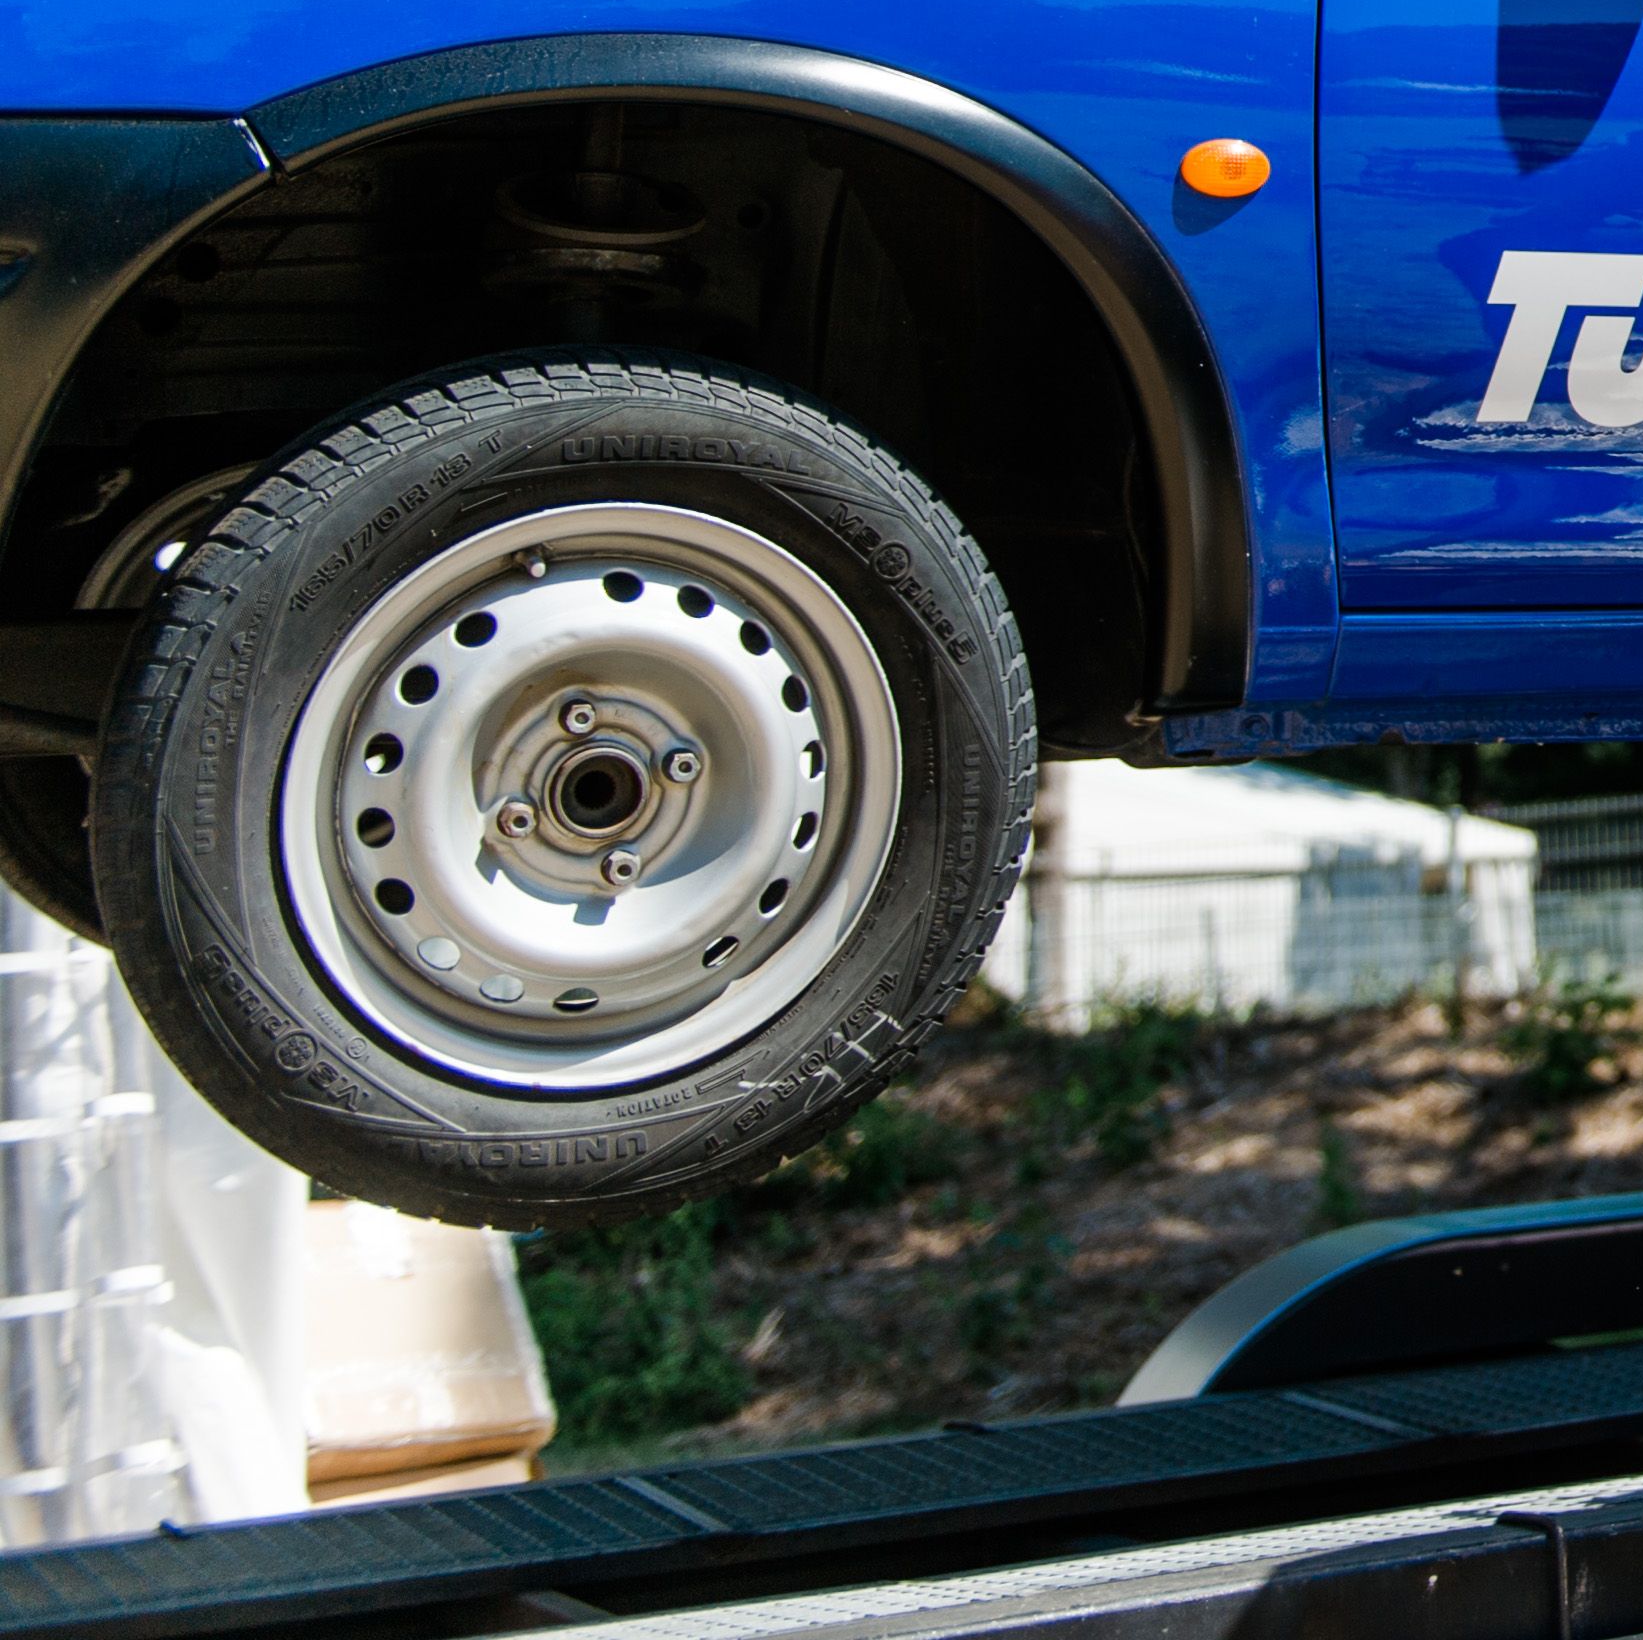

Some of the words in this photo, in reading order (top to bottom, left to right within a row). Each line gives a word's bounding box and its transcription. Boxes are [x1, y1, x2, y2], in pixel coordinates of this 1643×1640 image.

[562, 433, 812, 476] UNIROYAL
[195, 659, 235, 855] UNIROYAL
[950, 744, 980, 909] UNIROYAL
[393, 1128, 650, 1167] UNIROYAL
